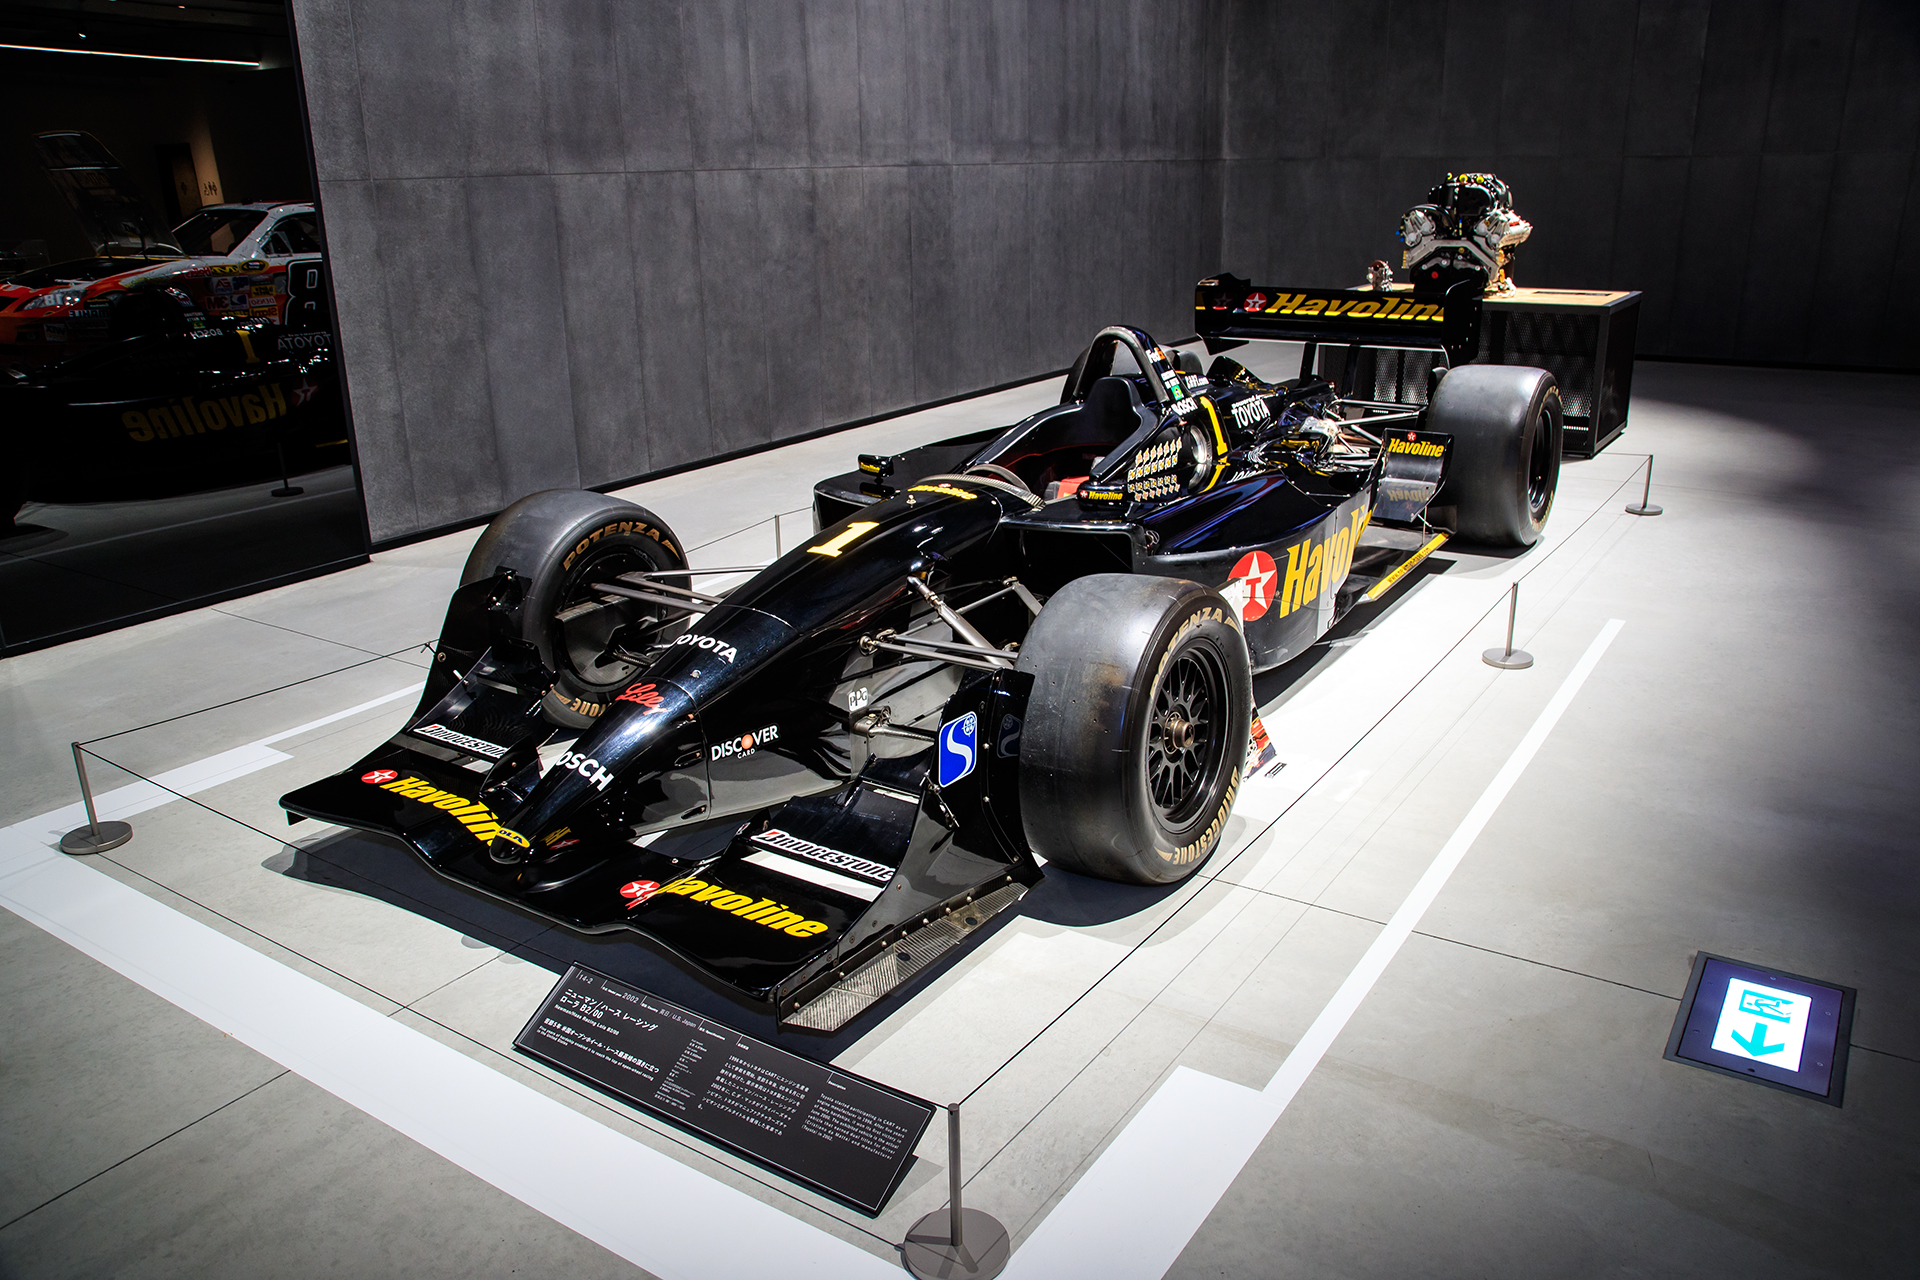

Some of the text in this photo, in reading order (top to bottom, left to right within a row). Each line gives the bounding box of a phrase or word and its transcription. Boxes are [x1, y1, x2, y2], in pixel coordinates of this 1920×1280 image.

[1170, 396, 1198, 416] BOSCH
[1231, 398, 1271, 429] TOYOTA
[1387, 437, 1445, 458] Havoline
[1088, 490, 1123, 501] Havoline
[562, 520, 660, 572] POTENZA
[806, 520, 880, 558] 1
[676, 633, 738, 664] OYOTA
[1149, 606, 1223, 701] POTENZA
[737, 747, 756, 760] CARD
[555, 750, 615, 792] OSCH
[378, 775, 502, 848] Havolin
[1172, 764, 1242, 866] BRIDGESTONE
[498, 829, 523, 845] OLA
[757, 832, 895, 880] BRIDGESTONE
[559, 995, 603, 1018] ローラ B2/00
[621, 992, 639, 1003] 2002
[581, 1015, 597, 1026] Racing
[622, 1012, 658, 1031] レーシング
